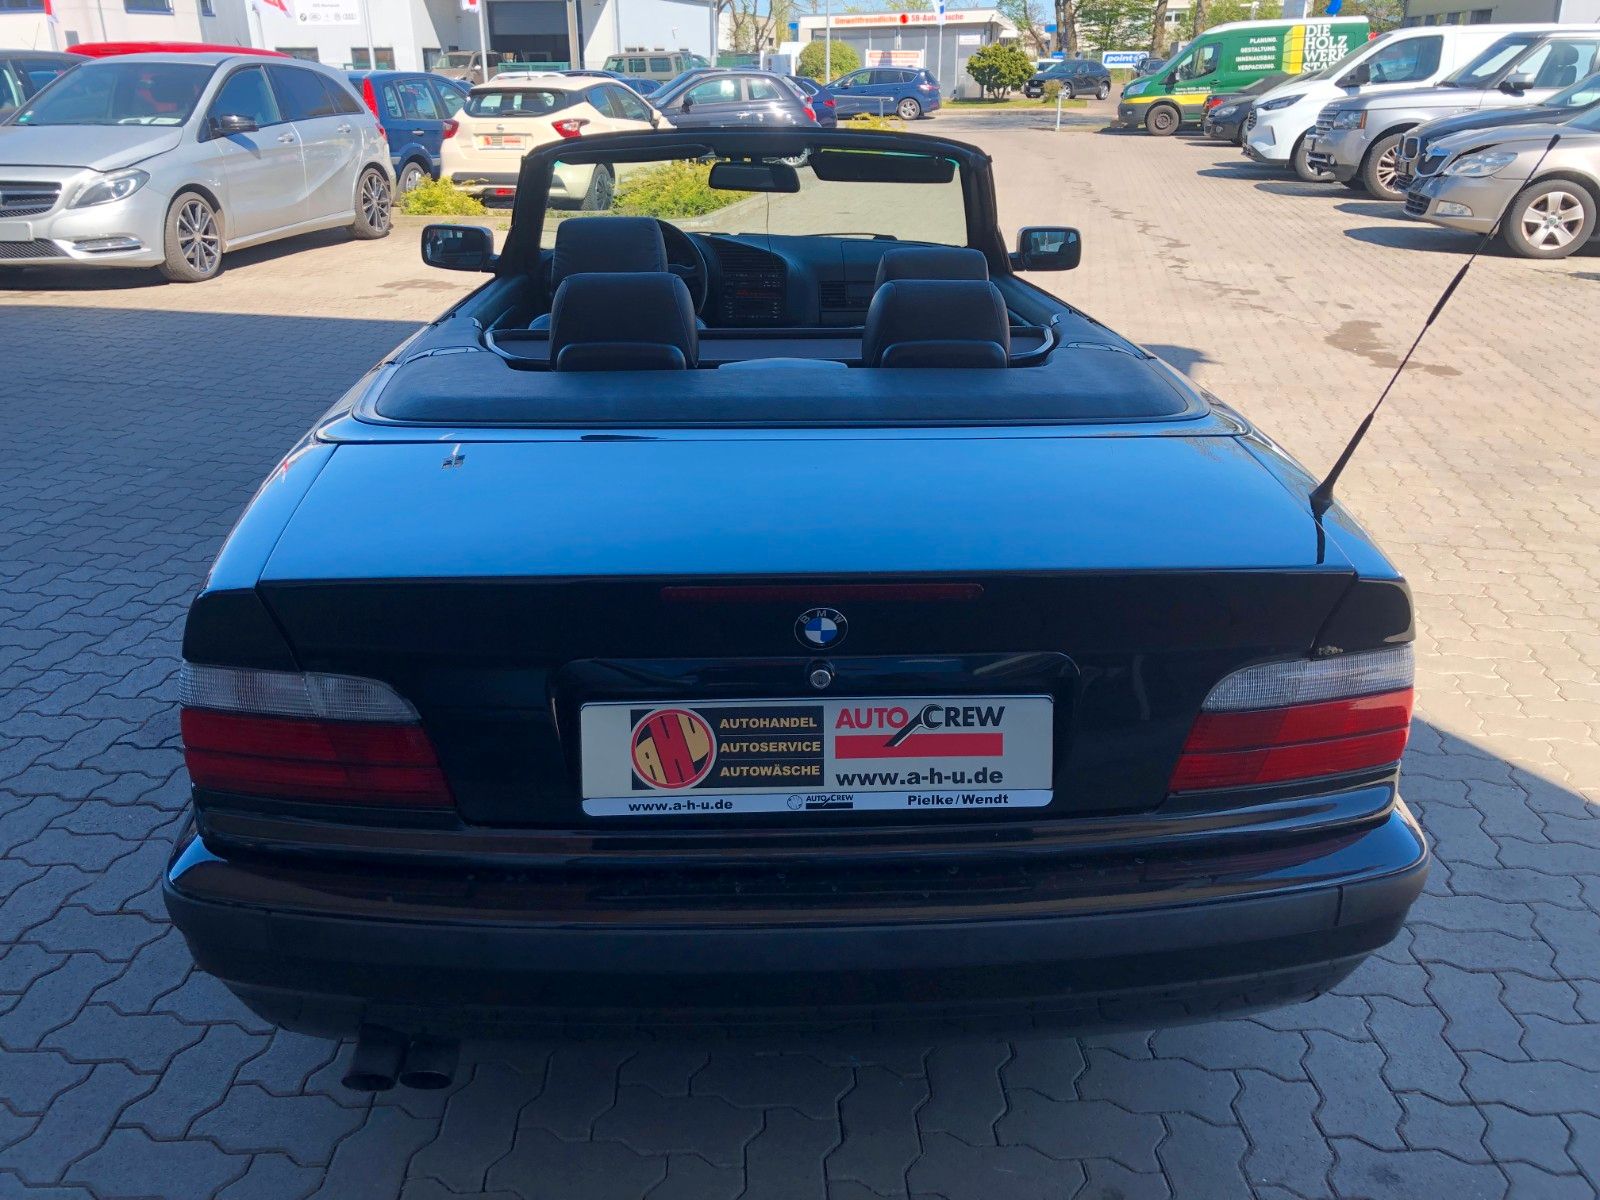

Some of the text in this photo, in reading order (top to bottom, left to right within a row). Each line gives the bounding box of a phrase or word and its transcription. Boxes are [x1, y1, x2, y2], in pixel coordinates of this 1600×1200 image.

[1305, 24, 1331, 37] DIE
[1304, 35, 1348, 50] HOLZ
[1304, 48, 1348, 61] WERK
[800, 610, 844, 624] BMW
[720, 717, 817, 729] AUTOHANDEL
[835, 704, 1006, 729] AUTO CREW
[720, 741, 821, 753] AUTOSERVICE
[720, 764, 821, 777] AUTOWÄSCHE
[835, 767, 1004, 787] www.a-h-u.de
[830, 794, 854, 802] CREW
[628, 799, 733, 812] www.a-h-u.de
